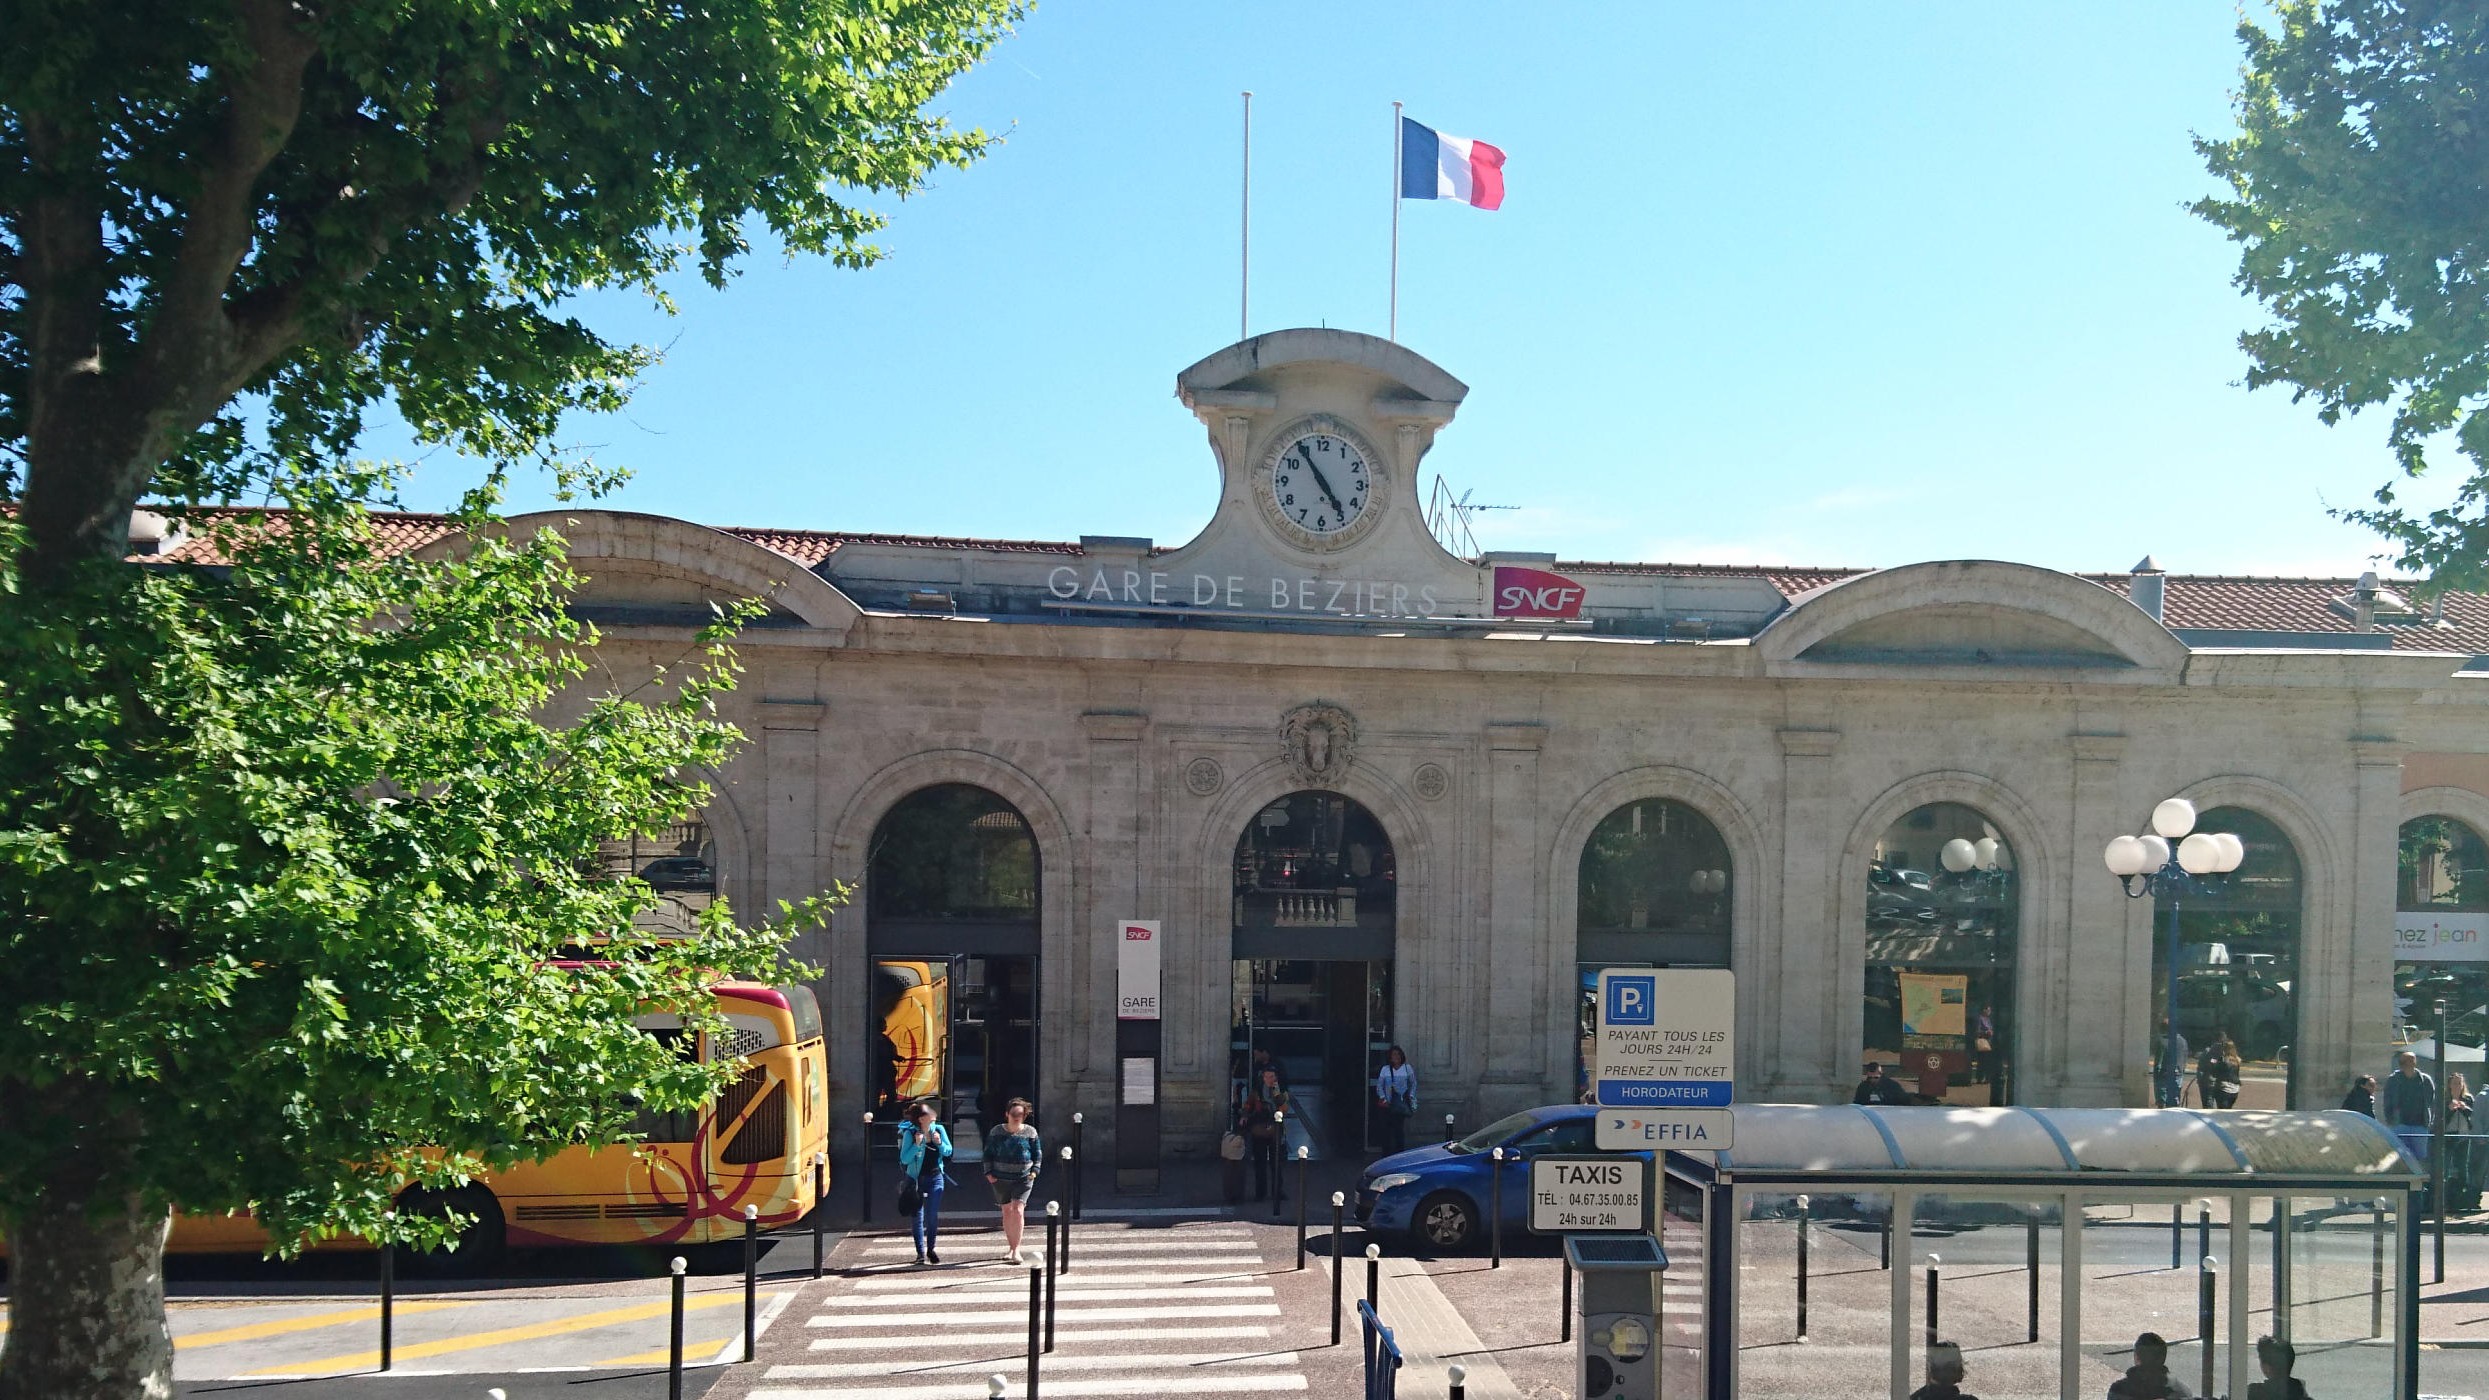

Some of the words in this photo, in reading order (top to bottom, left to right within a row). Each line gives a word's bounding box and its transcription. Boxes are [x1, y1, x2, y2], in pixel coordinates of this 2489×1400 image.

[1316, 440, 1330, 452] 12
[1340, 447, 1346, 459] 1
[1286, 458, 1300, 470] 10
[1351, 462, 1359, 473] 2
[1280, 475, 1289, 487] 9
[1356, 480, 1364, 491] 3
[1286, 494, 1294, 505] 8
[1350, 498, 1358, 508] 4
[1299, 509, 1308, 520] 7
[1337, 510, 1344, 522] 5
[1317, 516, 1325, 527] 6
[1048, 566, 1169, 604] GARE
[1193, 574, 1244, 607] DE
[1270, 577, 1438, 615] BEZIERS
[1497, 586, 1582, 611] SNCF
[1127, 931, 1150, 940] SNCF
[2432, 922, 2477, 946] jean
[1122, 997, 1156, 1008] GARE
[1620, 987, 1641, 1014] P
[1608, 1030, 1658, 1041] PAYANT
[1663, 1031, 1698, 1042] TOUS
[1702, 1031, 1725, 1042] LES
[1620, 1043, 1663, 1055] JOURS
[1668, 1044, 1712, 1055] 24H/24
[1604, 1065, 1654, 1076] PRENEZ
[1659, 1066, 1678, 1077] UN
[1683, 1066, 1728, 1077] TICKET
[1621, 1087, 1709, 1098] HORODATEUR
[1644, 1123, 1708, 1140] EFFIA
[1555, 1165, 1622, 1185] TAXIS
[1569, 1193, 1639, 1206] 04.67.35.00.85
[1559, 1212, 1577, 1225] 24h
[1580, 1215, 1596, 1225] sur
[1599, 1213, 1617, 1226] 24h
